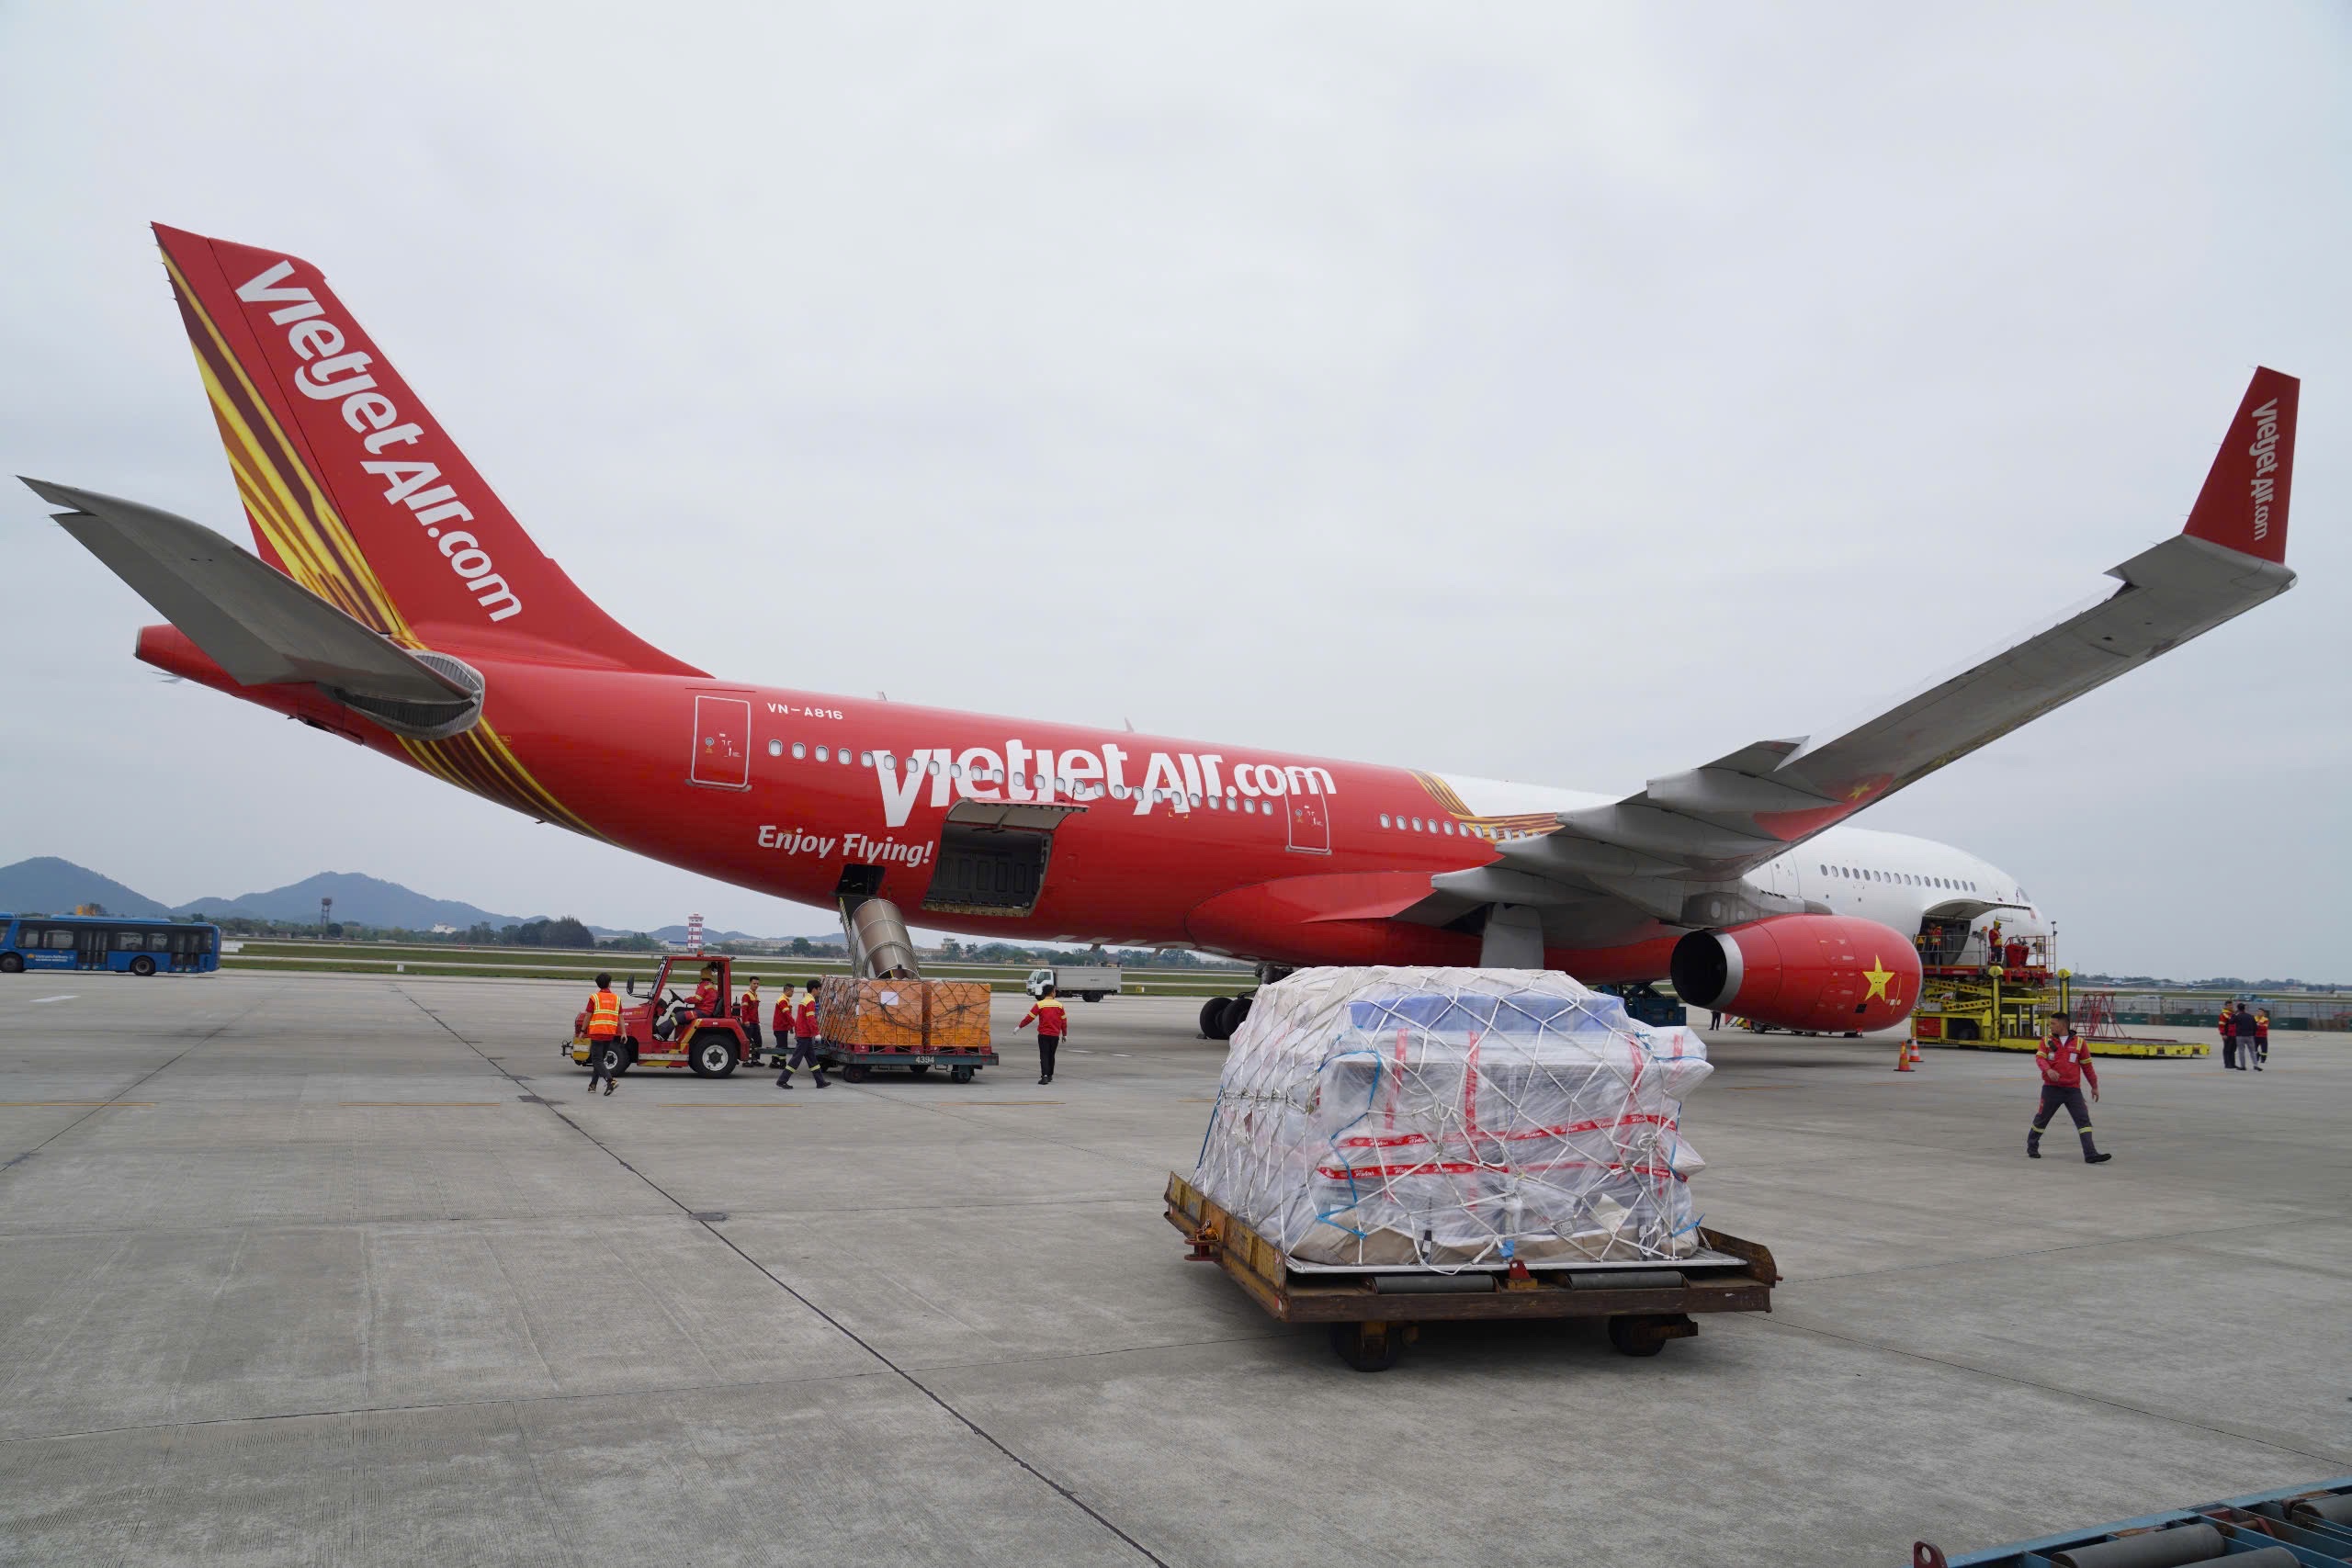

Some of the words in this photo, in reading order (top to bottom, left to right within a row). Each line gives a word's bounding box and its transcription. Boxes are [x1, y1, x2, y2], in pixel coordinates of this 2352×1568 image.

[757, 825, 837, 859] Enjoy
[842, 833, 934, 868] Flying!
[915, 1055, 935, 1064] 4394
